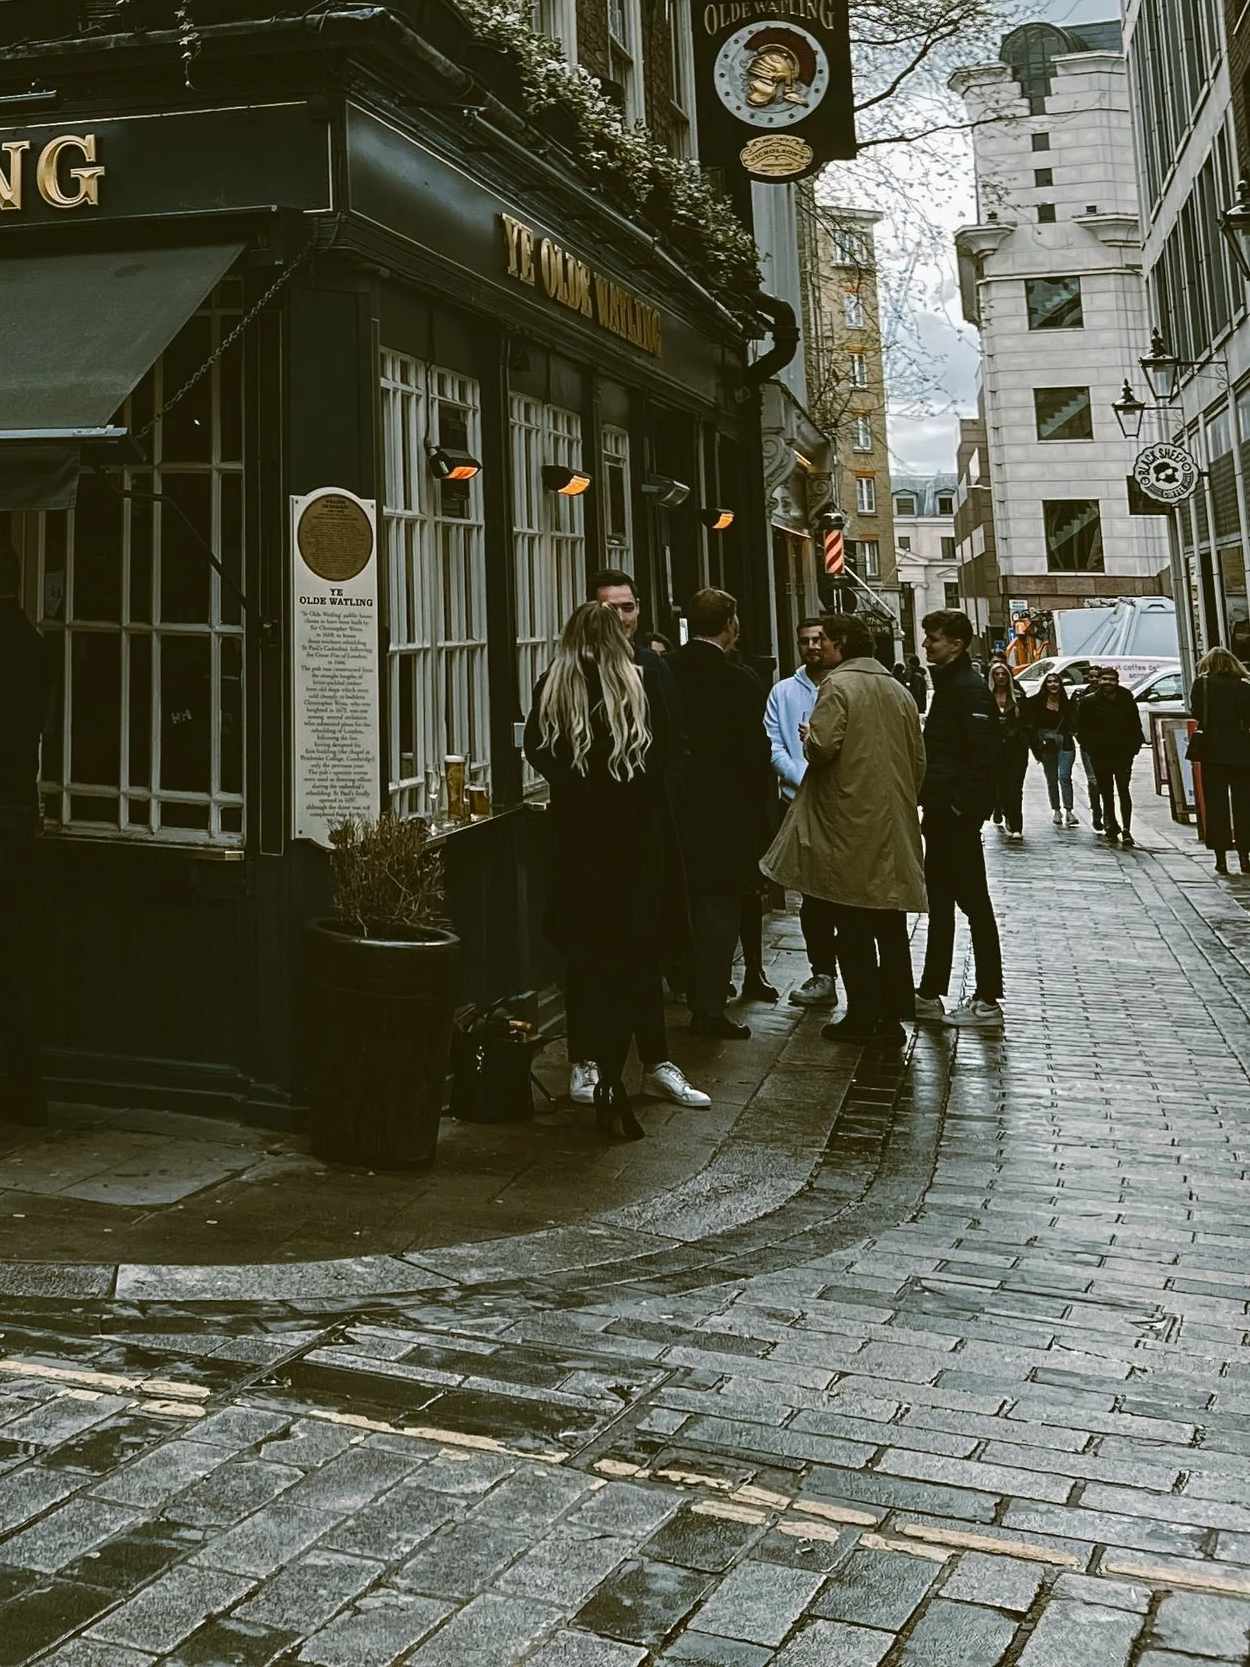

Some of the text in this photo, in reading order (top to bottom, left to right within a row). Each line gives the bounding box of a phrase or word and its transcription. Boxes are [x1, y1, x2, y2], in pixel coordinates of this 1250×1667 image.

[704, 2, 751, 35] OLDE
[501, 212, 662, 358] YE OLDE WATLING
[1138, 447, 1187, 475] BLACK SHEEP
[1162, 484, 1188, 498] COFFEE
[299, 596, 373, 607] OLDE WATLING
[330, 588, 344, 596] YE
